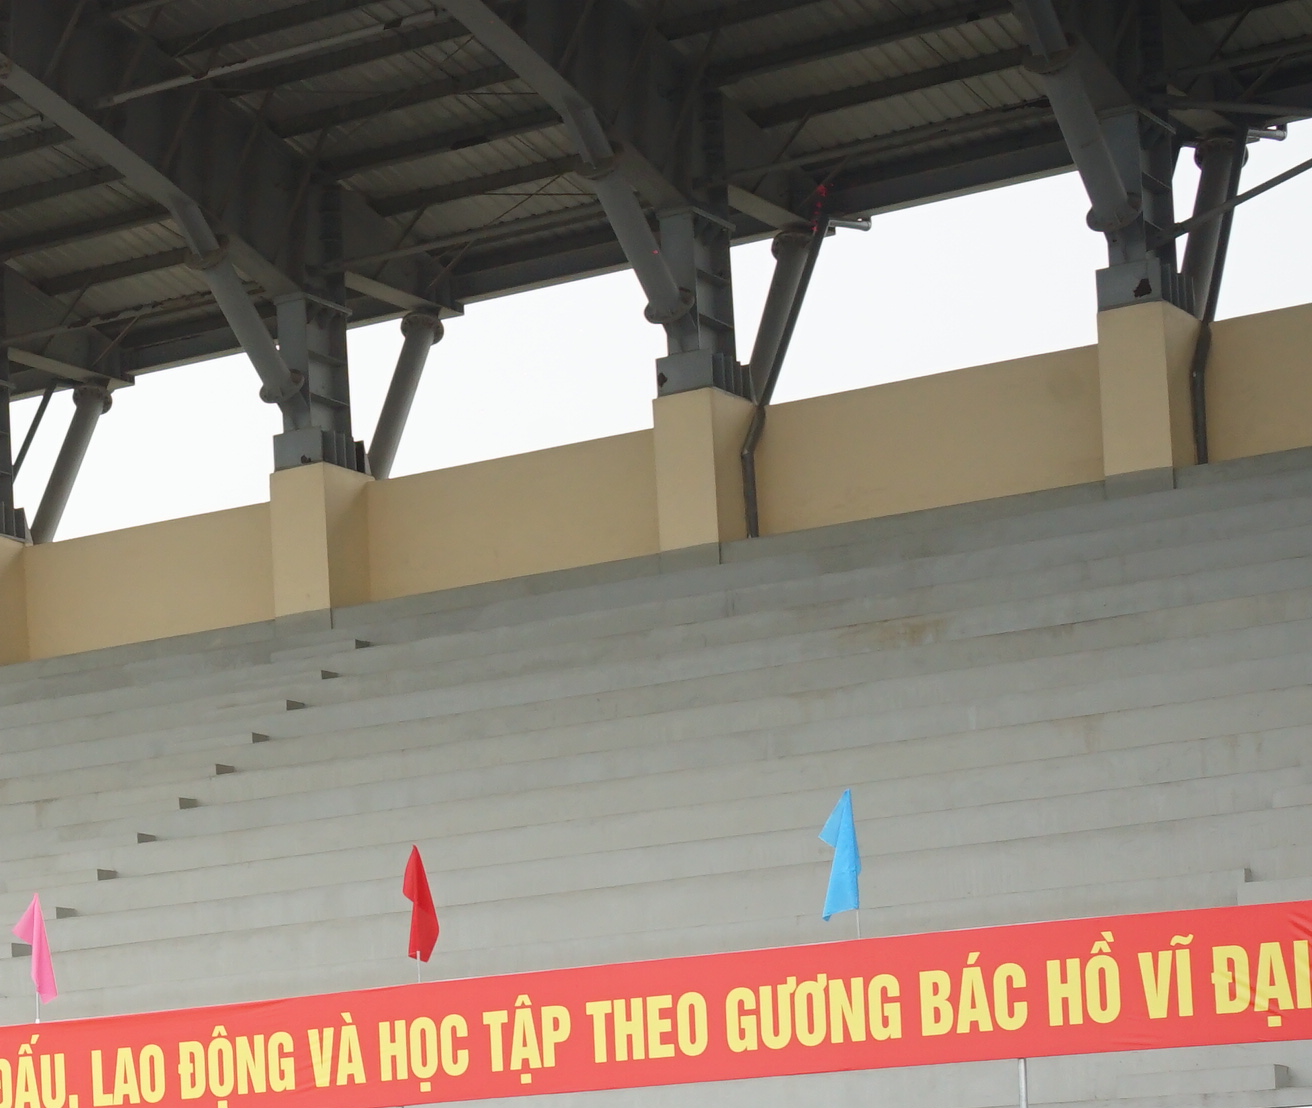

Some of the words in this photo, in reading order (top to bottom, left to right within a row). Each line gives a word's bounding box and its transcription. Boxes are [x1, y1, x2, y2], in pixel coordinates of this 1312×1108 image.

[91, 1043, 166, 1107] LAO
[307, 1011, 367, 1088] VÀ
[378, 1013, 470, 1093] HỌC
[482, 994, 572, 1085] TẬP
[585, 991, 709, 1064] THEO
[725, 973, 902, 1053] GƯƠNG
[918, 951, 1028, 1037] BÁC
[1046, 931, 1121, 1027] HỒ
[1137, 933, 1194, 1019] VĨ
[1210, 939, 1312, 1028] ĐẠI
